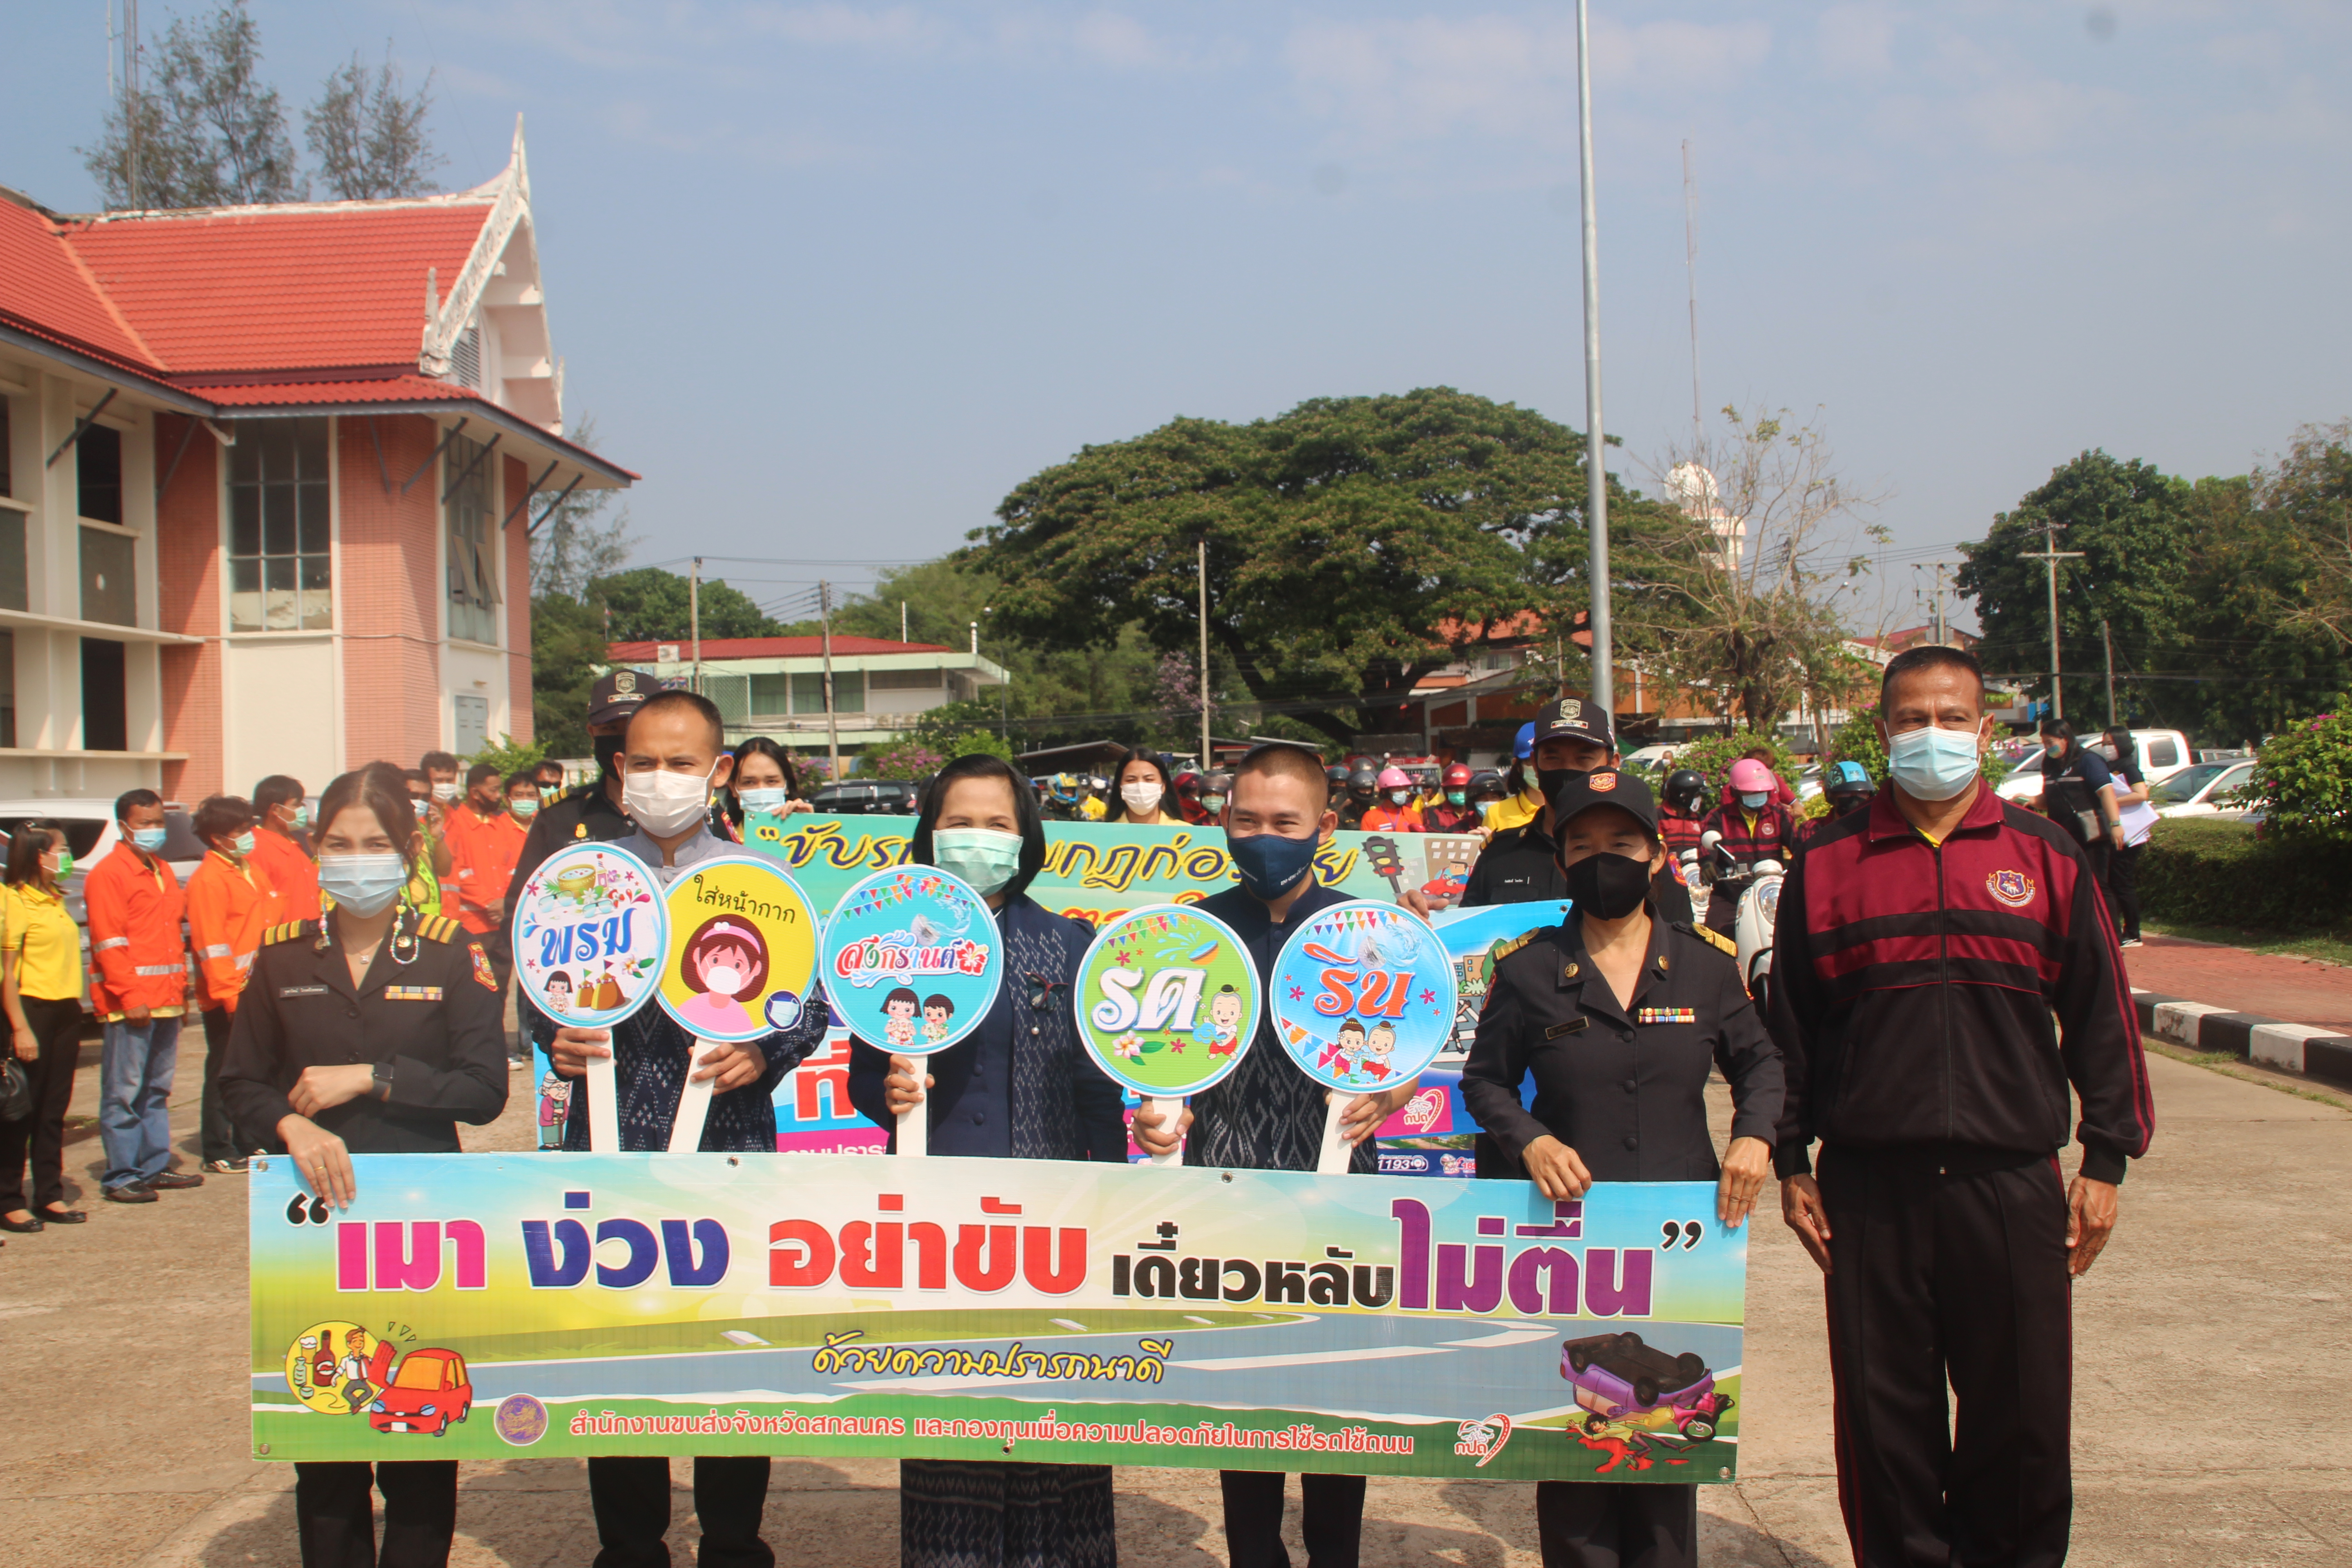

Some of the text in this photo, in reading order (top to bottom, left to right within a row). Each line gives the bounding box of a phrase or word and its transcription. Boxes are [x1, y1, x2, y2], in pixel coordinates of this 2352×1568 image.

[694, 874, 796, 924] ใส่หน้ากาก
[541, 907, 637, 967] พรม
[837, 936, 963, 976] สงกรานต์
[1302, 942, 1416, 1018] ริน
[1378, 1159, 1410, 1170] 1193
[520, 1191, 730, 1289] ง่วง
[769, 1193, 1088, 1294] อย่าขับ
[813, 1331, 1173, 1383] ด้วยความปรารถนาดี
[570, 1409, 1413, 1454] สำนักงานขนส่งจังหวัดสกลนคร และกองทุนเพื่อความปลอดภัยในการใช้รถใช้ถนน
[1455, 1442, 1487, 1455] กปถ
